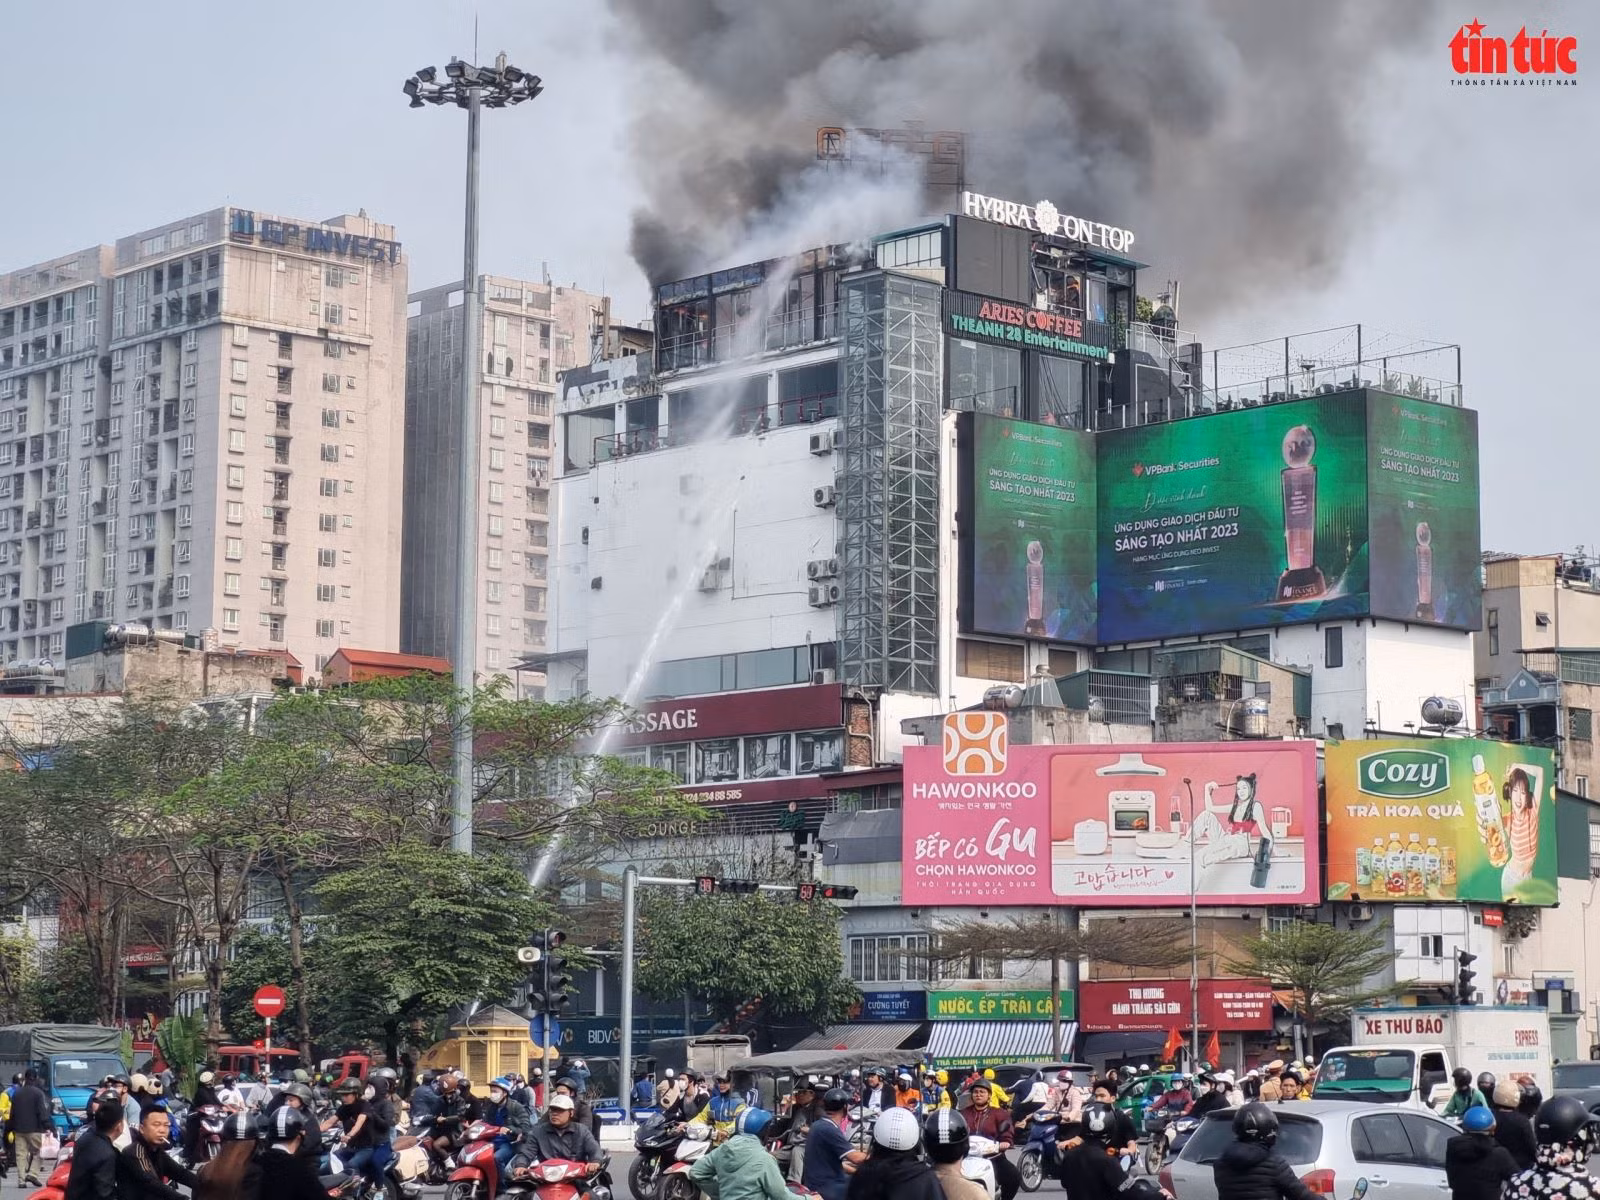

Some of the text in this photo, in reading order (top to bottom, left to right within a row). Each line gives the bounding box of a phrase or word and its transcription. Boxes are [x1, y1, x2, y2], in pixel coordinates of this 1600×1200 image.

[962, 190, 1135, 253] HYBRA ON TOP
[261, 219, 402, 265] GP INVEST
[979, 301, 1082, 338] ARIES COFFEE
[952, 314, 1109, 360] THEANH 28 Entertainment
[1145, 456, 1220, 476] VPBank Securities
[1381, 456, 1403, 472] SÁNG
[1404, 462, 1420, 477] TẠO
[1441, 470, 1460, 482] 2023
[1022, 473, 1038, 483] GIAO
[989, 477, 1076, 503] SÁNG TẠO NHẤT 2023
[1114, 520, 1133, 534] ỨNG
[1134, 518, 1159, 532] DỤNG
[1160, 515, 1183, 528] GIAO
[1184, 512, 1206, 526] DỊCH
[1115, 523, 1239, 552] SÁNG TẠO NHẤT 2023
[1368, 759, 1438, 788] Cozy
[912, 782, 1037, 799] HAWONKOO
[1346, 800, 1464, 819] TRÀ HOA QUẢ
[914, 831, 951, 860] BẾP
[915, 864, 1036, 878] CHỌN HAWONKOO
[1074, 862, 1155, 891] 고맙습니다
[951, 887, 1006, 895] HÀN QUỐC
[868, 999, 910, 1010] CƯỜNG TUYẾT
[938, 996, 1063, 1014] NƯỚC ÉP TRÁI CÂ
[1154, 1001, 1167, 1014] SÀI
[1365, 1014, 1443, 1035] XE THƯ BÁO
[588, 1030, 612, 1044] BIDV
[1514, 1030, 1539, 1046] EXPRESS
